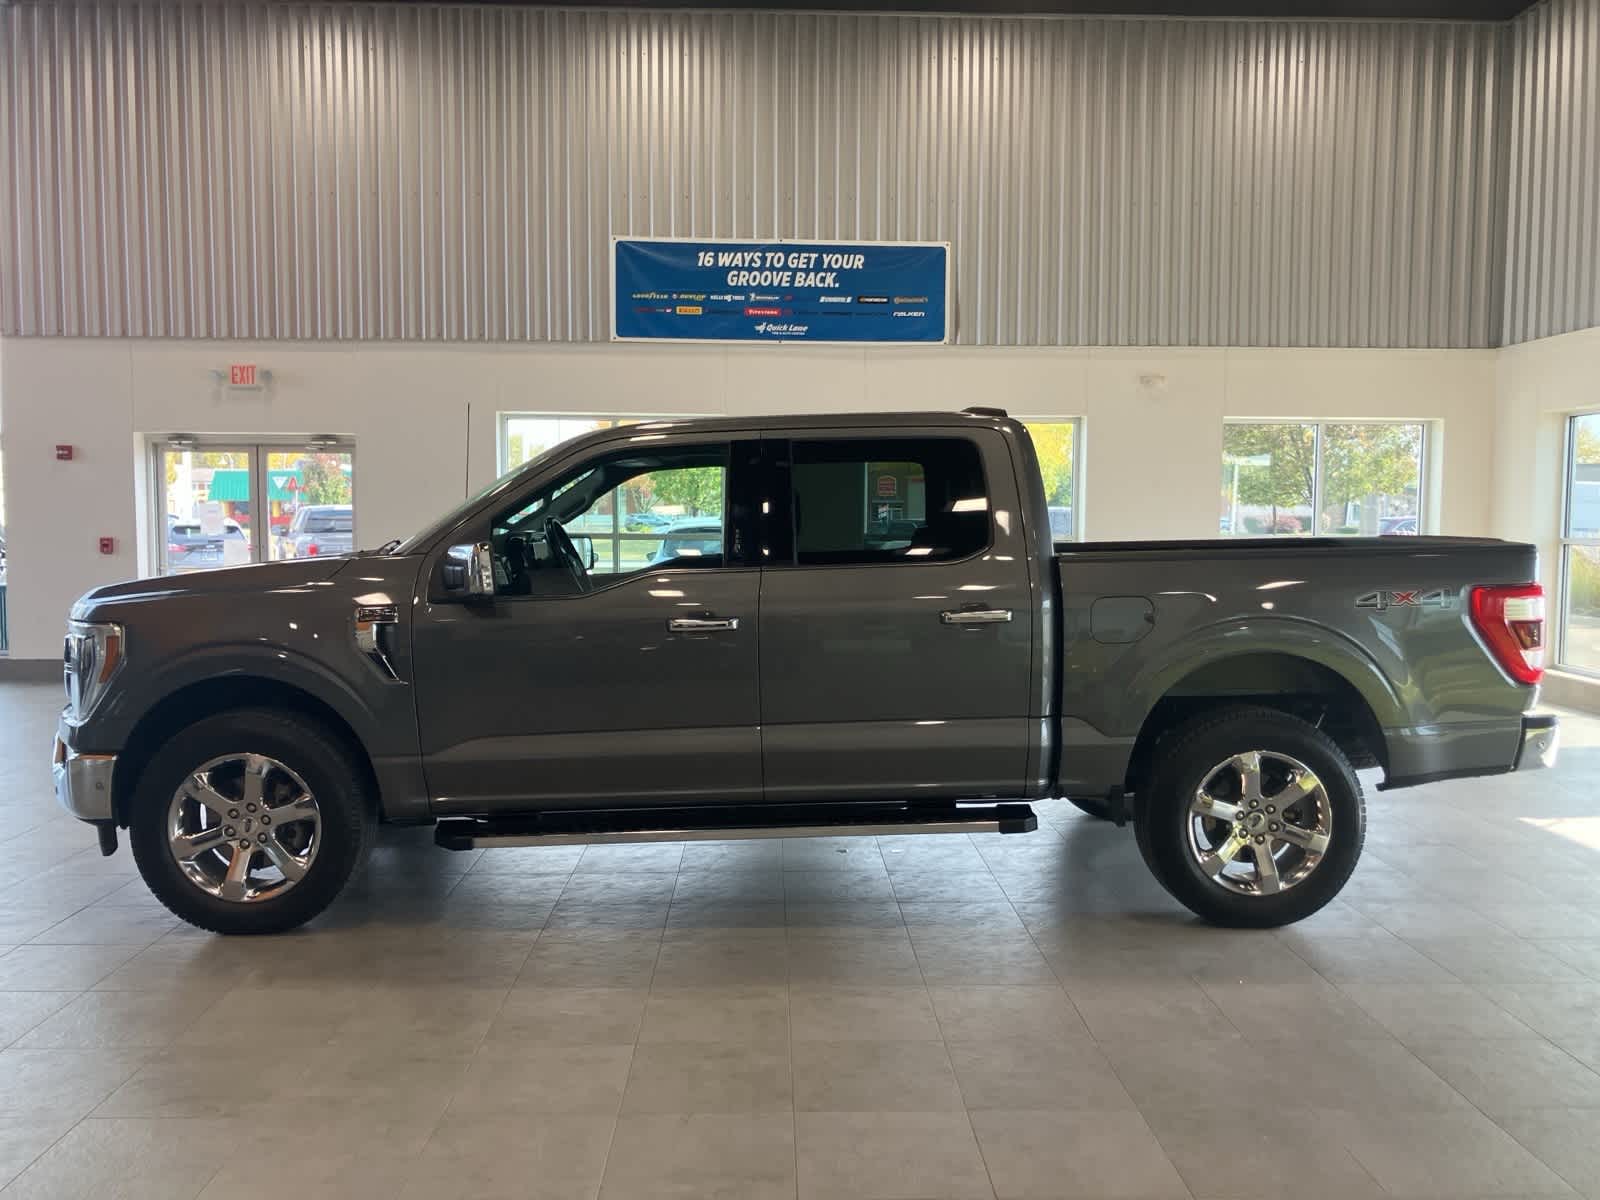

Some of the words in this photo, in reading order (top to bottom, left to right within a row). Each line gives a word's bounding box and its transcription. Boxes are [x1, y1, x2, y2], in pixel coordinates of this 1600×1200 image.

[697, 252, 714, 267] 16
[718, 252, 761, 268] WAYS
[765, 252, 784, 268] TO
[788, 253, 818, 269] GET
[822, 253, 865, 269] YOUR
[727, 271, 792, 287] GROOVE
[794, 272, 839, 288] BACK.
[766, 323, 788, 332] Quick
[789, 324, 808, 332] Lane
[231, 364, 257, 385] EXIT
